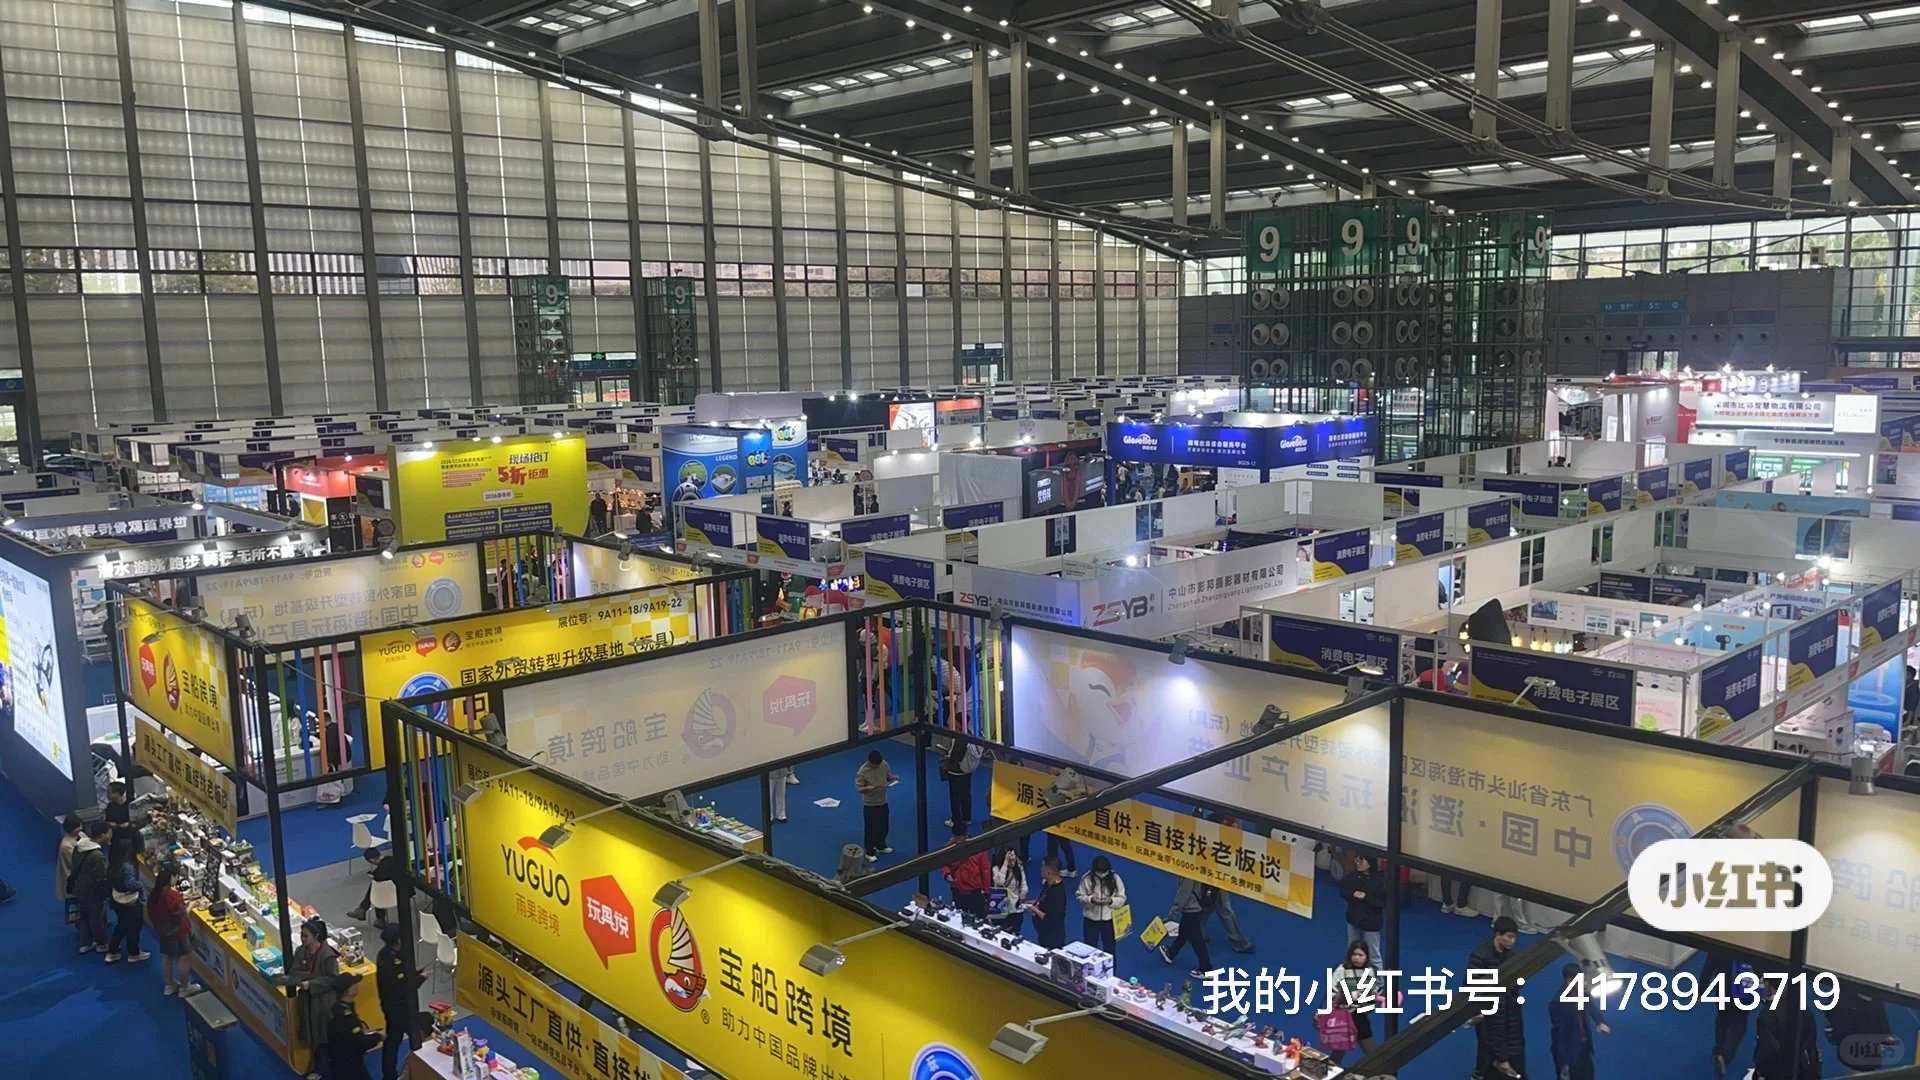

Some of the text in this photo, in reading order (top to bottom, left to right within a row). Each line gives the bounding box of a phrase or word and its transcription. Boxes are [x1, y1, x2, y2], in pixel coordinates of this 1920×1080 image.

[1259, 226, 1280, 262] 9
[1342, 219, 1364, 256] 9
[1406, 217, 1421, 255] 9
[1535, 226, 1546, 259] 9
[545, 284, 557, 305] 9
[674, 286, 686, 304] 9
[134, 559, 166, 575] 游泳
[169, 555, 200, 571] 跑步
[1336, 544, 1367, 560] 消费电子展区
[892, 574, 930, 590] 消费电子展区
[1168, 564, 1285, 600] 中山市影邦摄影器材有限公司
[378, 643, 412, 656] YUGUO
[465, 626, 503, 640] 宝船跨境
[1533, 685, 1620, 711] 消费电子展区
[500, 843, 571, 907] YUGUO
[515, 892, 561, 938] 雨果跨境
[586, 896, 630, 939] 玩具说
[718, 946, 853, 1058] 宝船跨境
